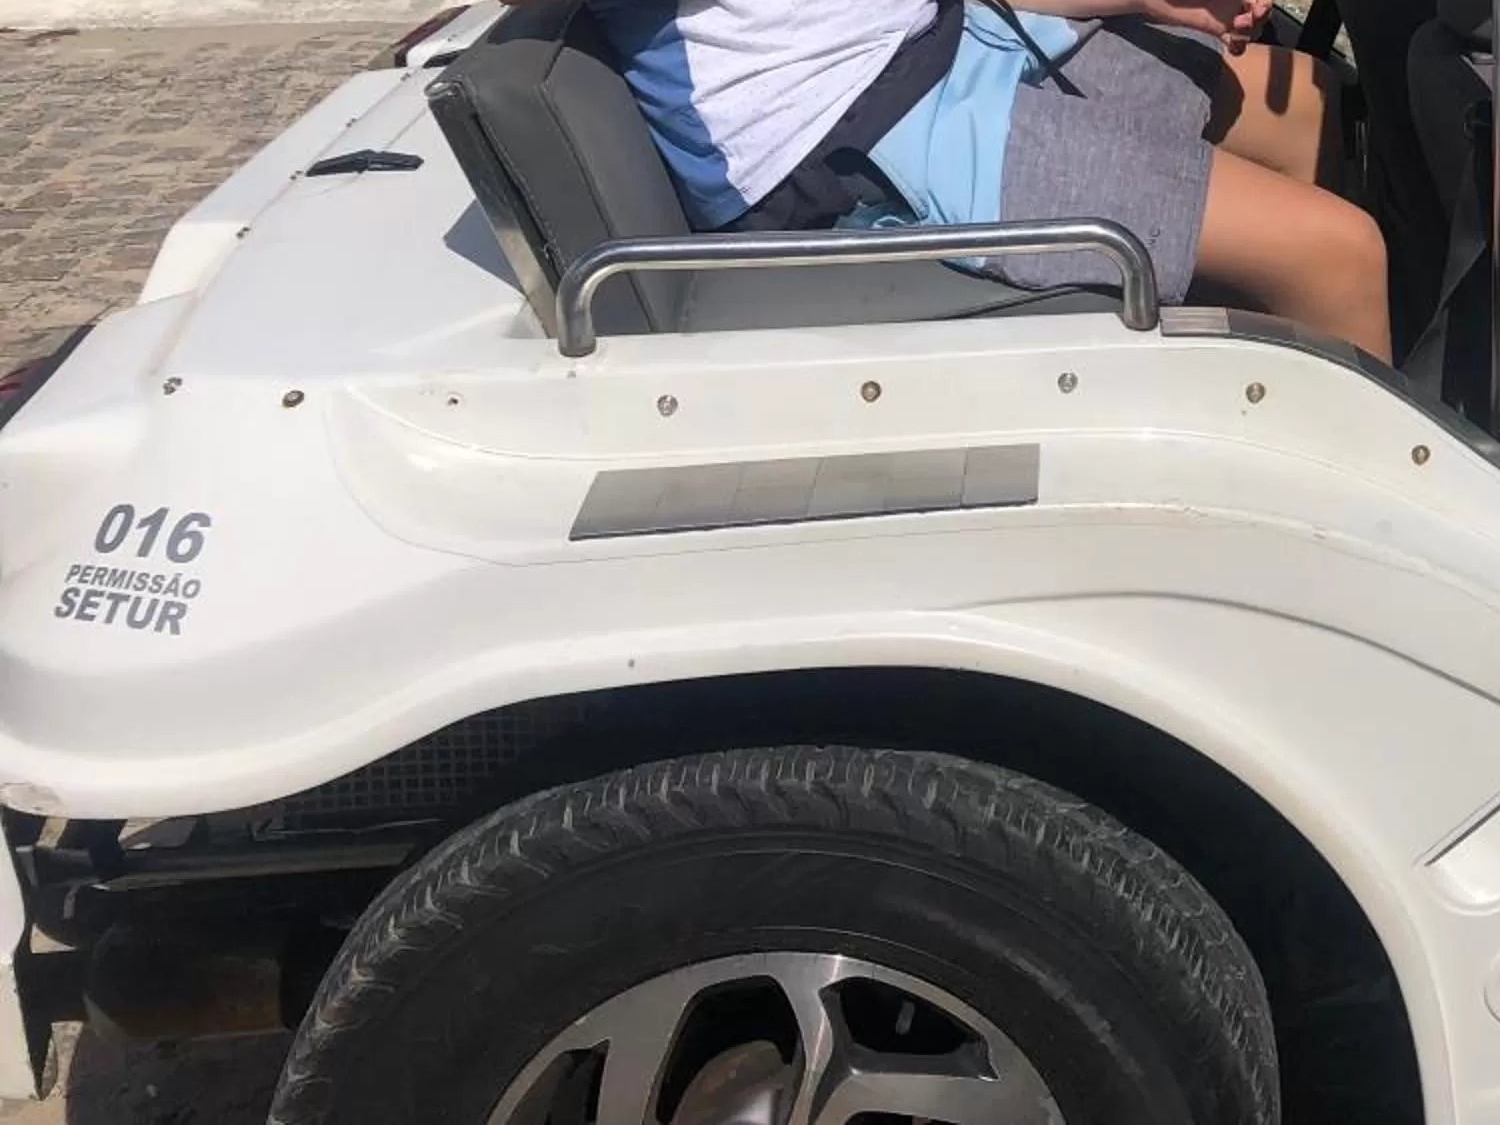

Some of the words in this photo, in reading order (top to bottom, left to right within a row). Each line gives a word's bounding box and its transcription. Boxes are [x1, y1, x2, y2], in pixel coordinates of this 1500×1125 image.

[94, 503, 212, 564] 016
[65, 564, 201, 599] PERMISSÃO
[54, 587, 188, 636] SETUR
